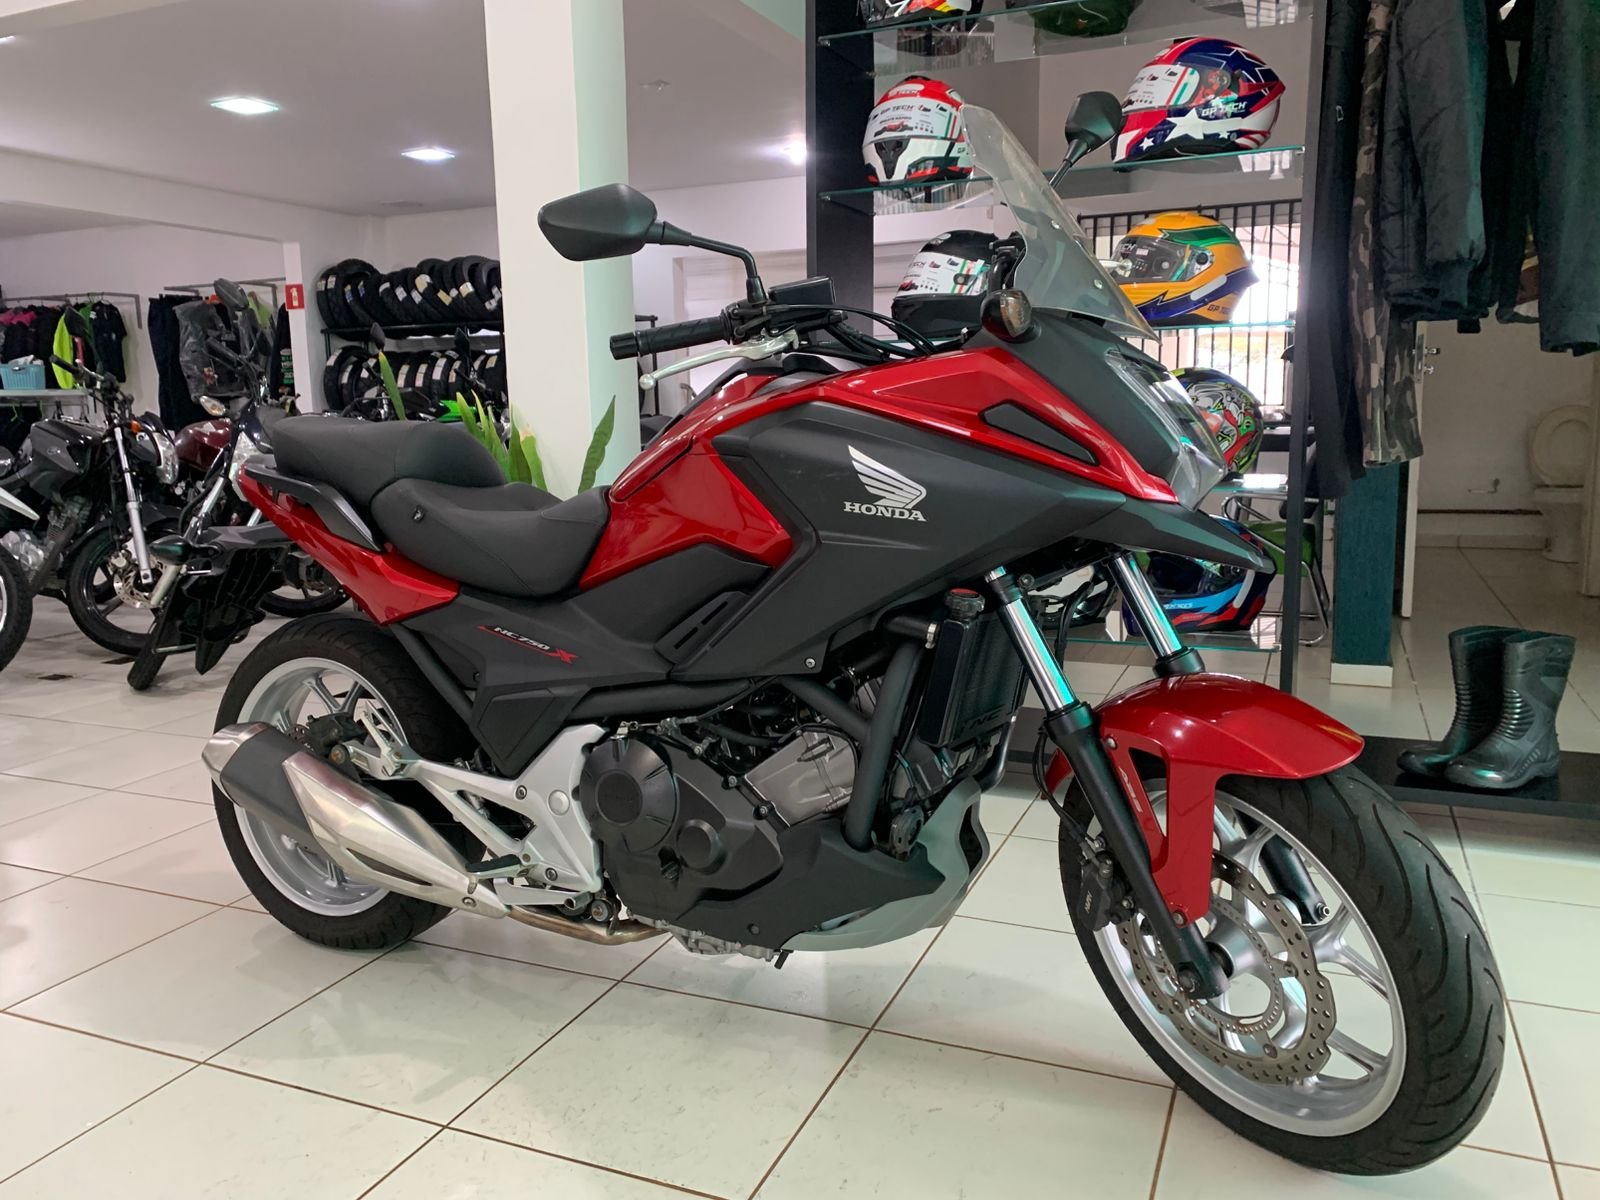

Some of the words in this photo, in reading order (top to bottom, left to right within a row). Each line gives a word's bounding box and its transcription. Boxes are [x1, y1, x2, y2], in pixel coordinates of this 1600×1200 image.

[1201, 107, 1219, 118] GP
[1220, 101, 1248, 114] TECH
[843, 501, 927, 522] HONDA
[494, 627, 550, 650] NC750
